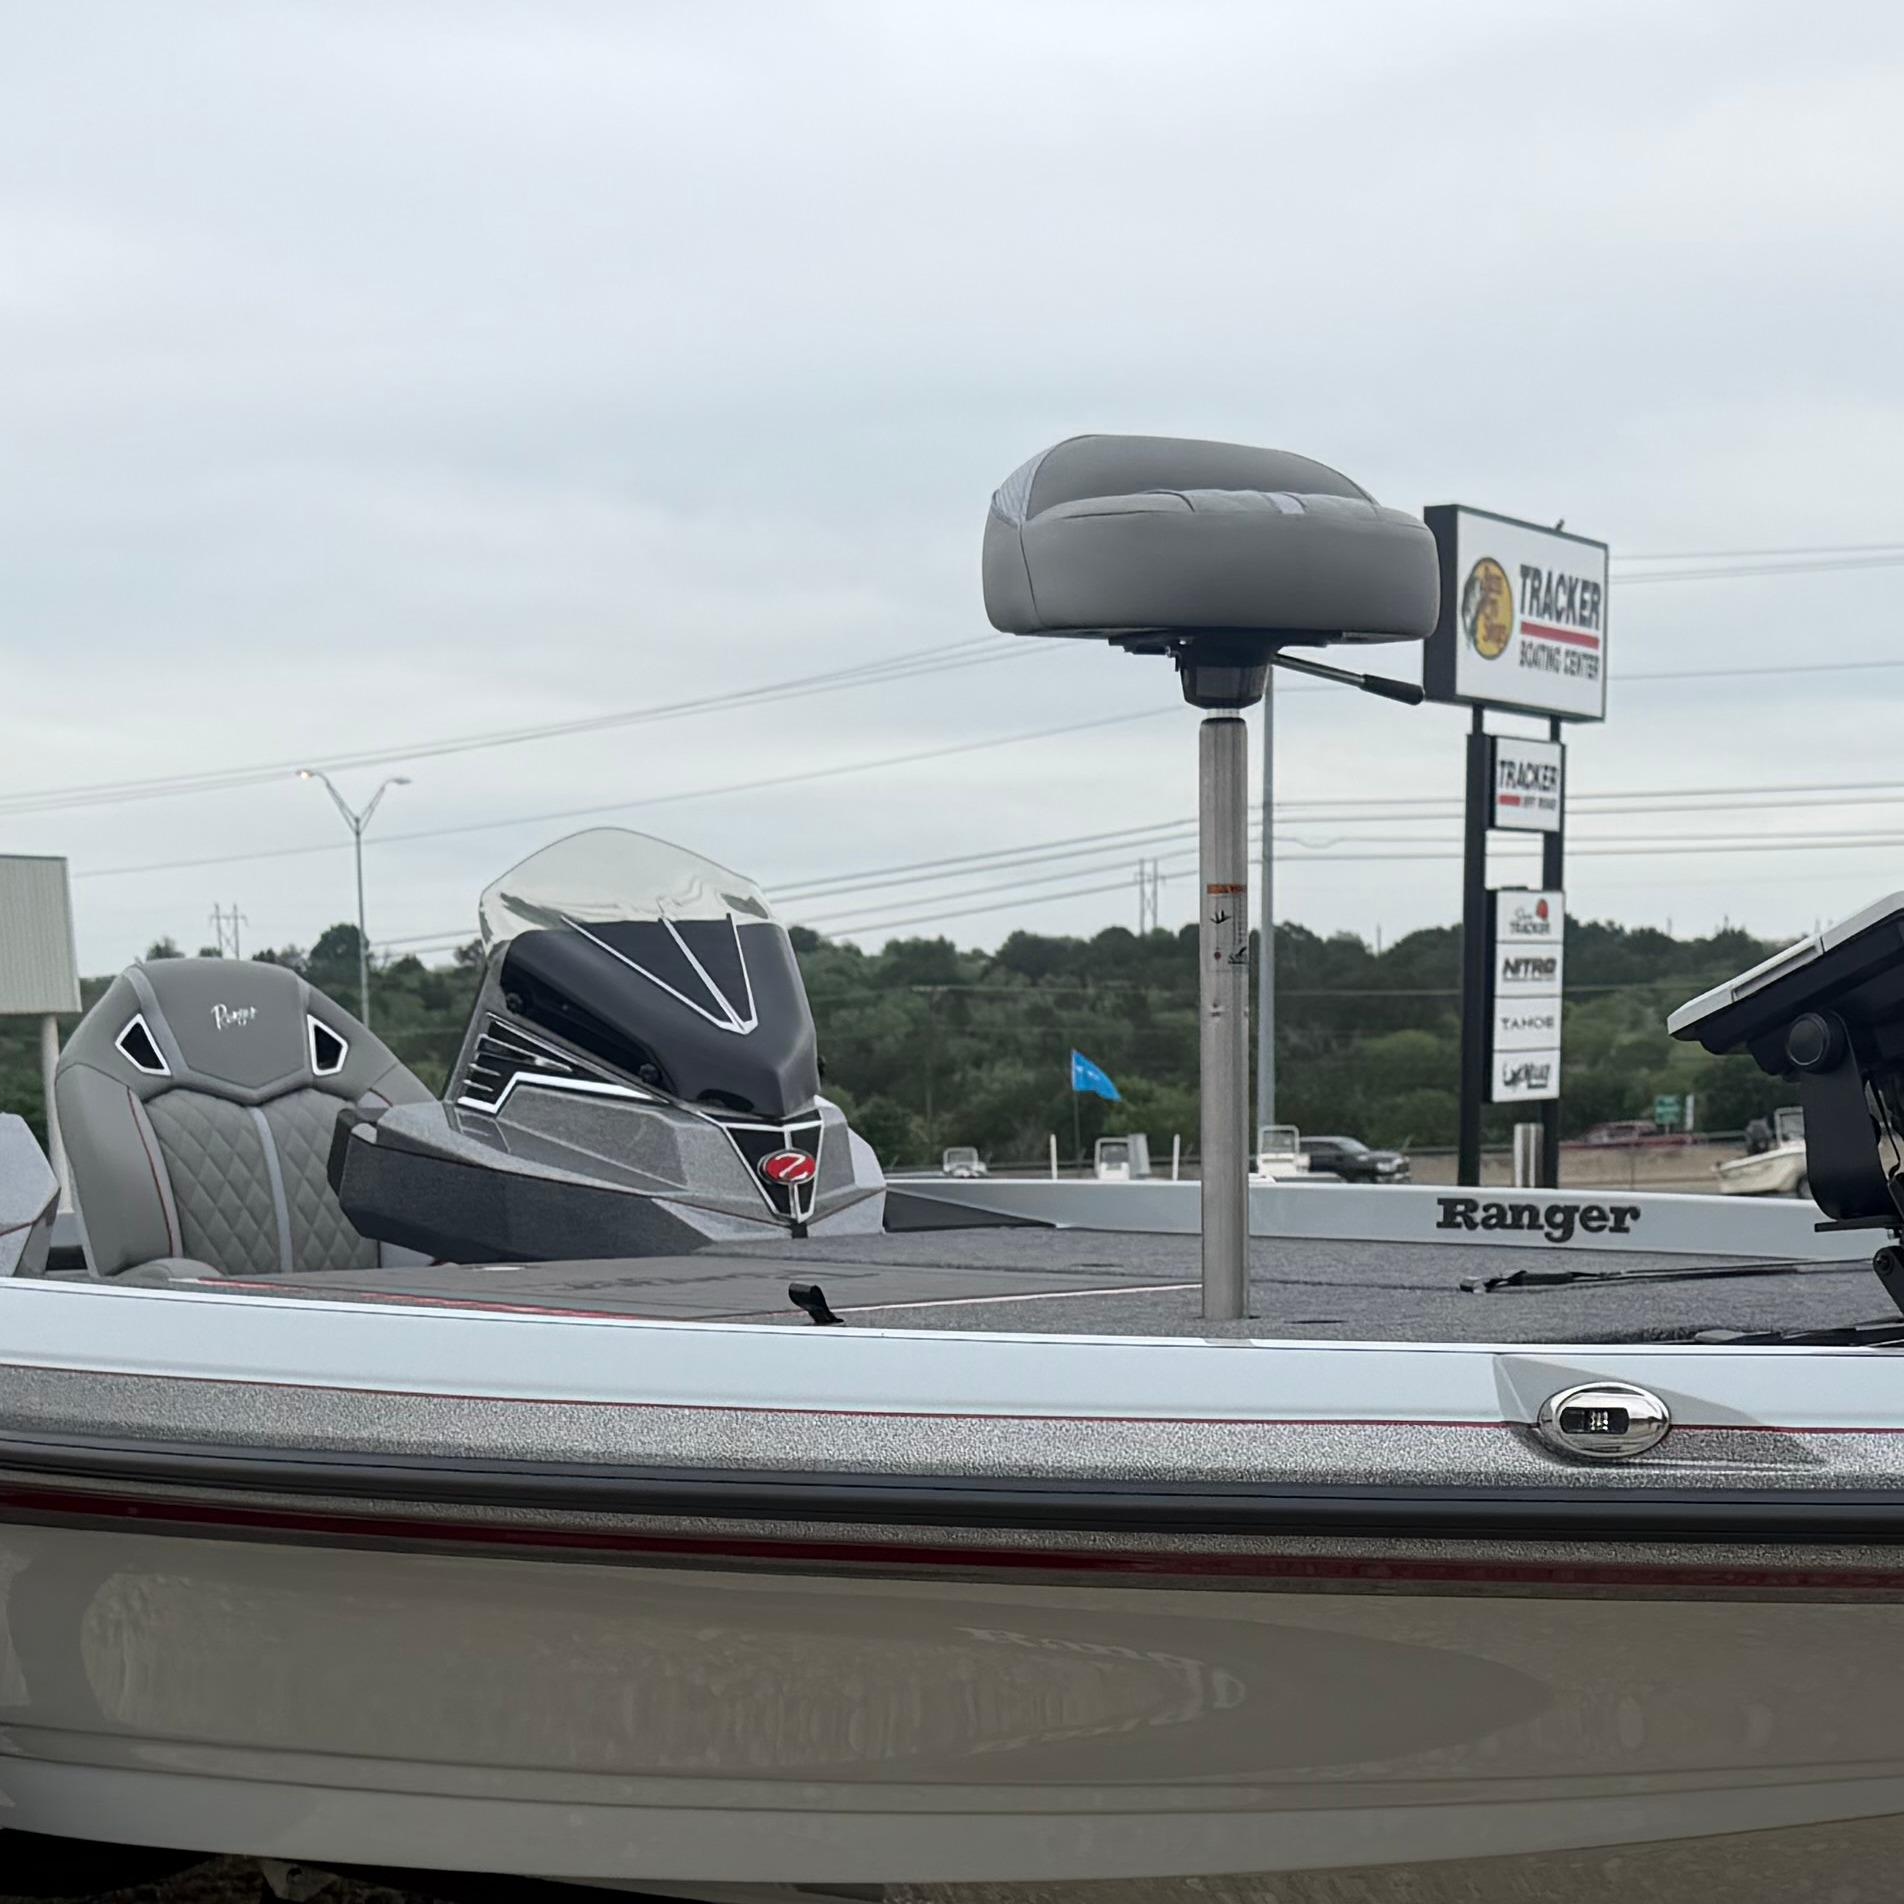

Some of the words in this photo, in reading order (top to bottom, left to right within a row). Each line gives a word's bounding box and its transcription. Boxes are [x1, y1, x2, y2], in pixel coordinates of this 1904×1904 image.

[1520, 563, 1601, 631] TRACKER
[1563, 646, 1600, 681] CENTER
[1500, 760, 1558, 792] TRACKER
[1503, 957, 1557, 975] NITRO
[1501, 1015, 1554, 1030] TAHOE
[1436, 1198, 1641, 1243] Ranger
